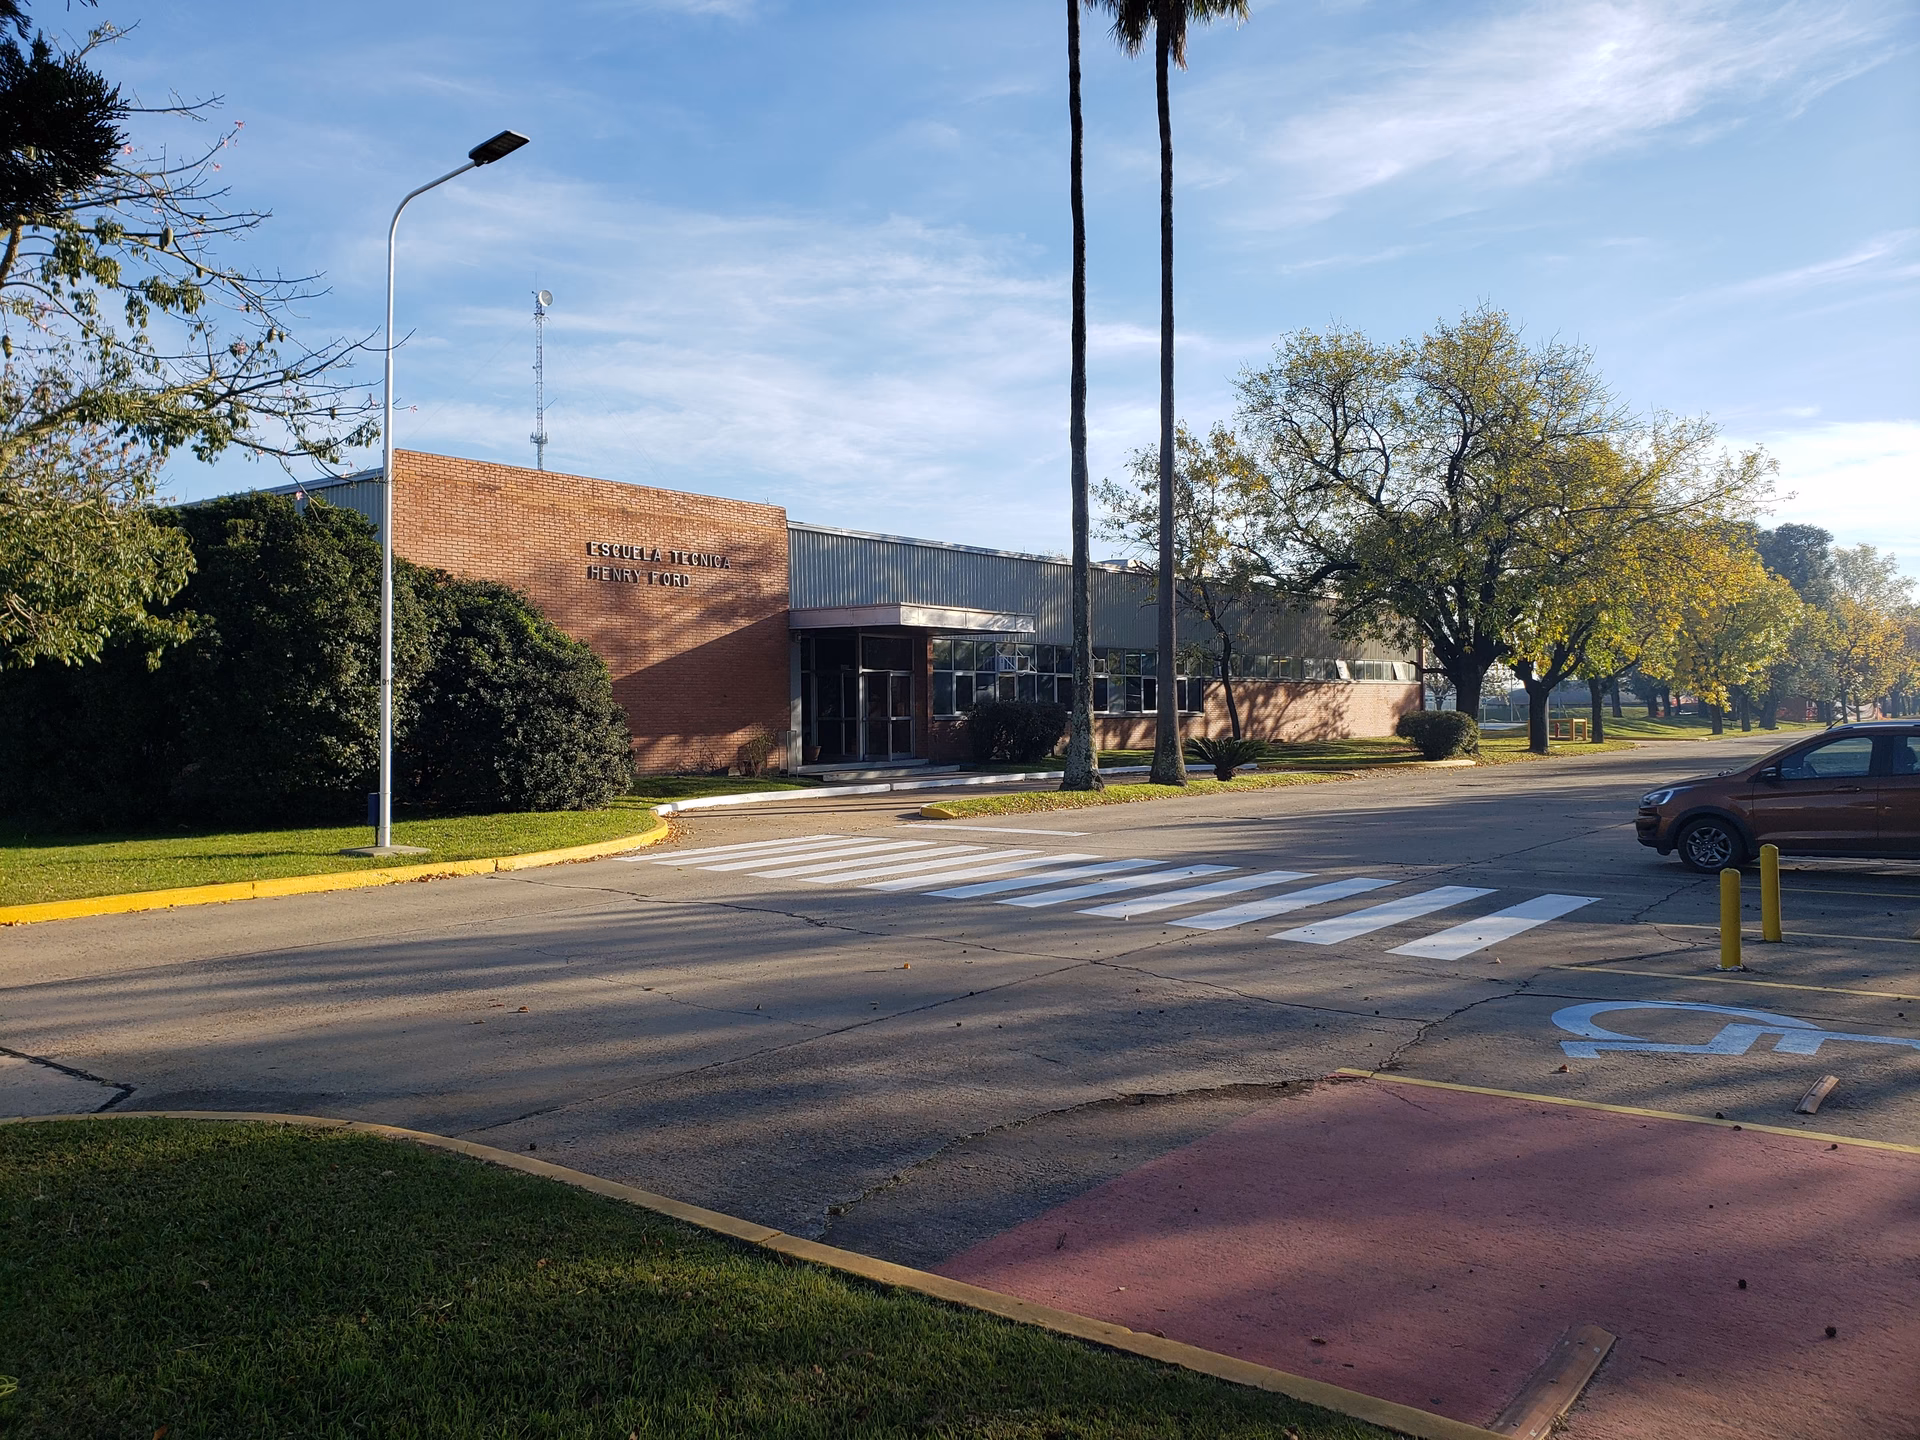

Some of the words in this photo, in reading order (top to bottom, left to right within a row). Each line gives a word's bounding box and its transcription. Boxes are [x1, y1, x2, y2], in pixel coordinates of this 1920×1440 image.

[588, 541, 662, 562] ESCUELA
[671, 549, 731, 569] TECNICA
[589, 565, 641, 583] HENRY
[650, 571, 691, 587] FORD
